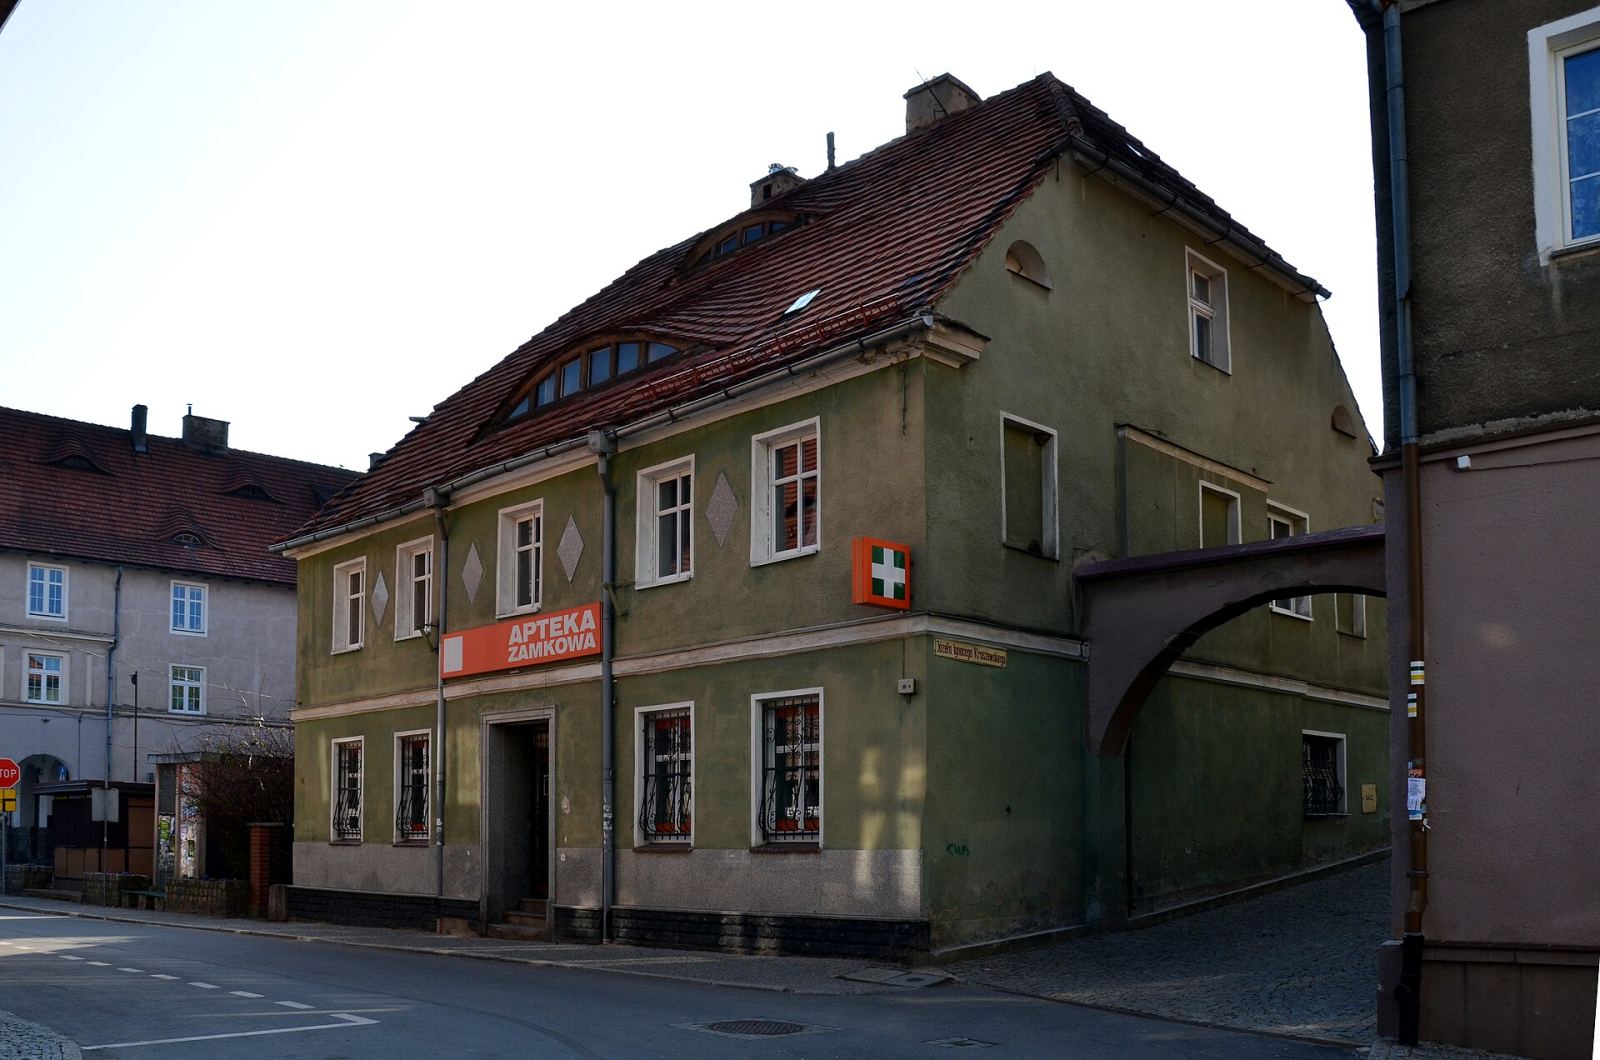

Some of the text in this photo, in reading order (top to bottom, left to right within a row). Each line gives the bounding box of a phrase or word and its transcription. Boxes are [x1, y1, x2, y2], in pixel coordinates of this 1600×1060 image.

[508, 610, 596, 645] APTEKA
[508, 633, 596, 663] ZAMKOWA
[0, 769, 17, 778] TOP
